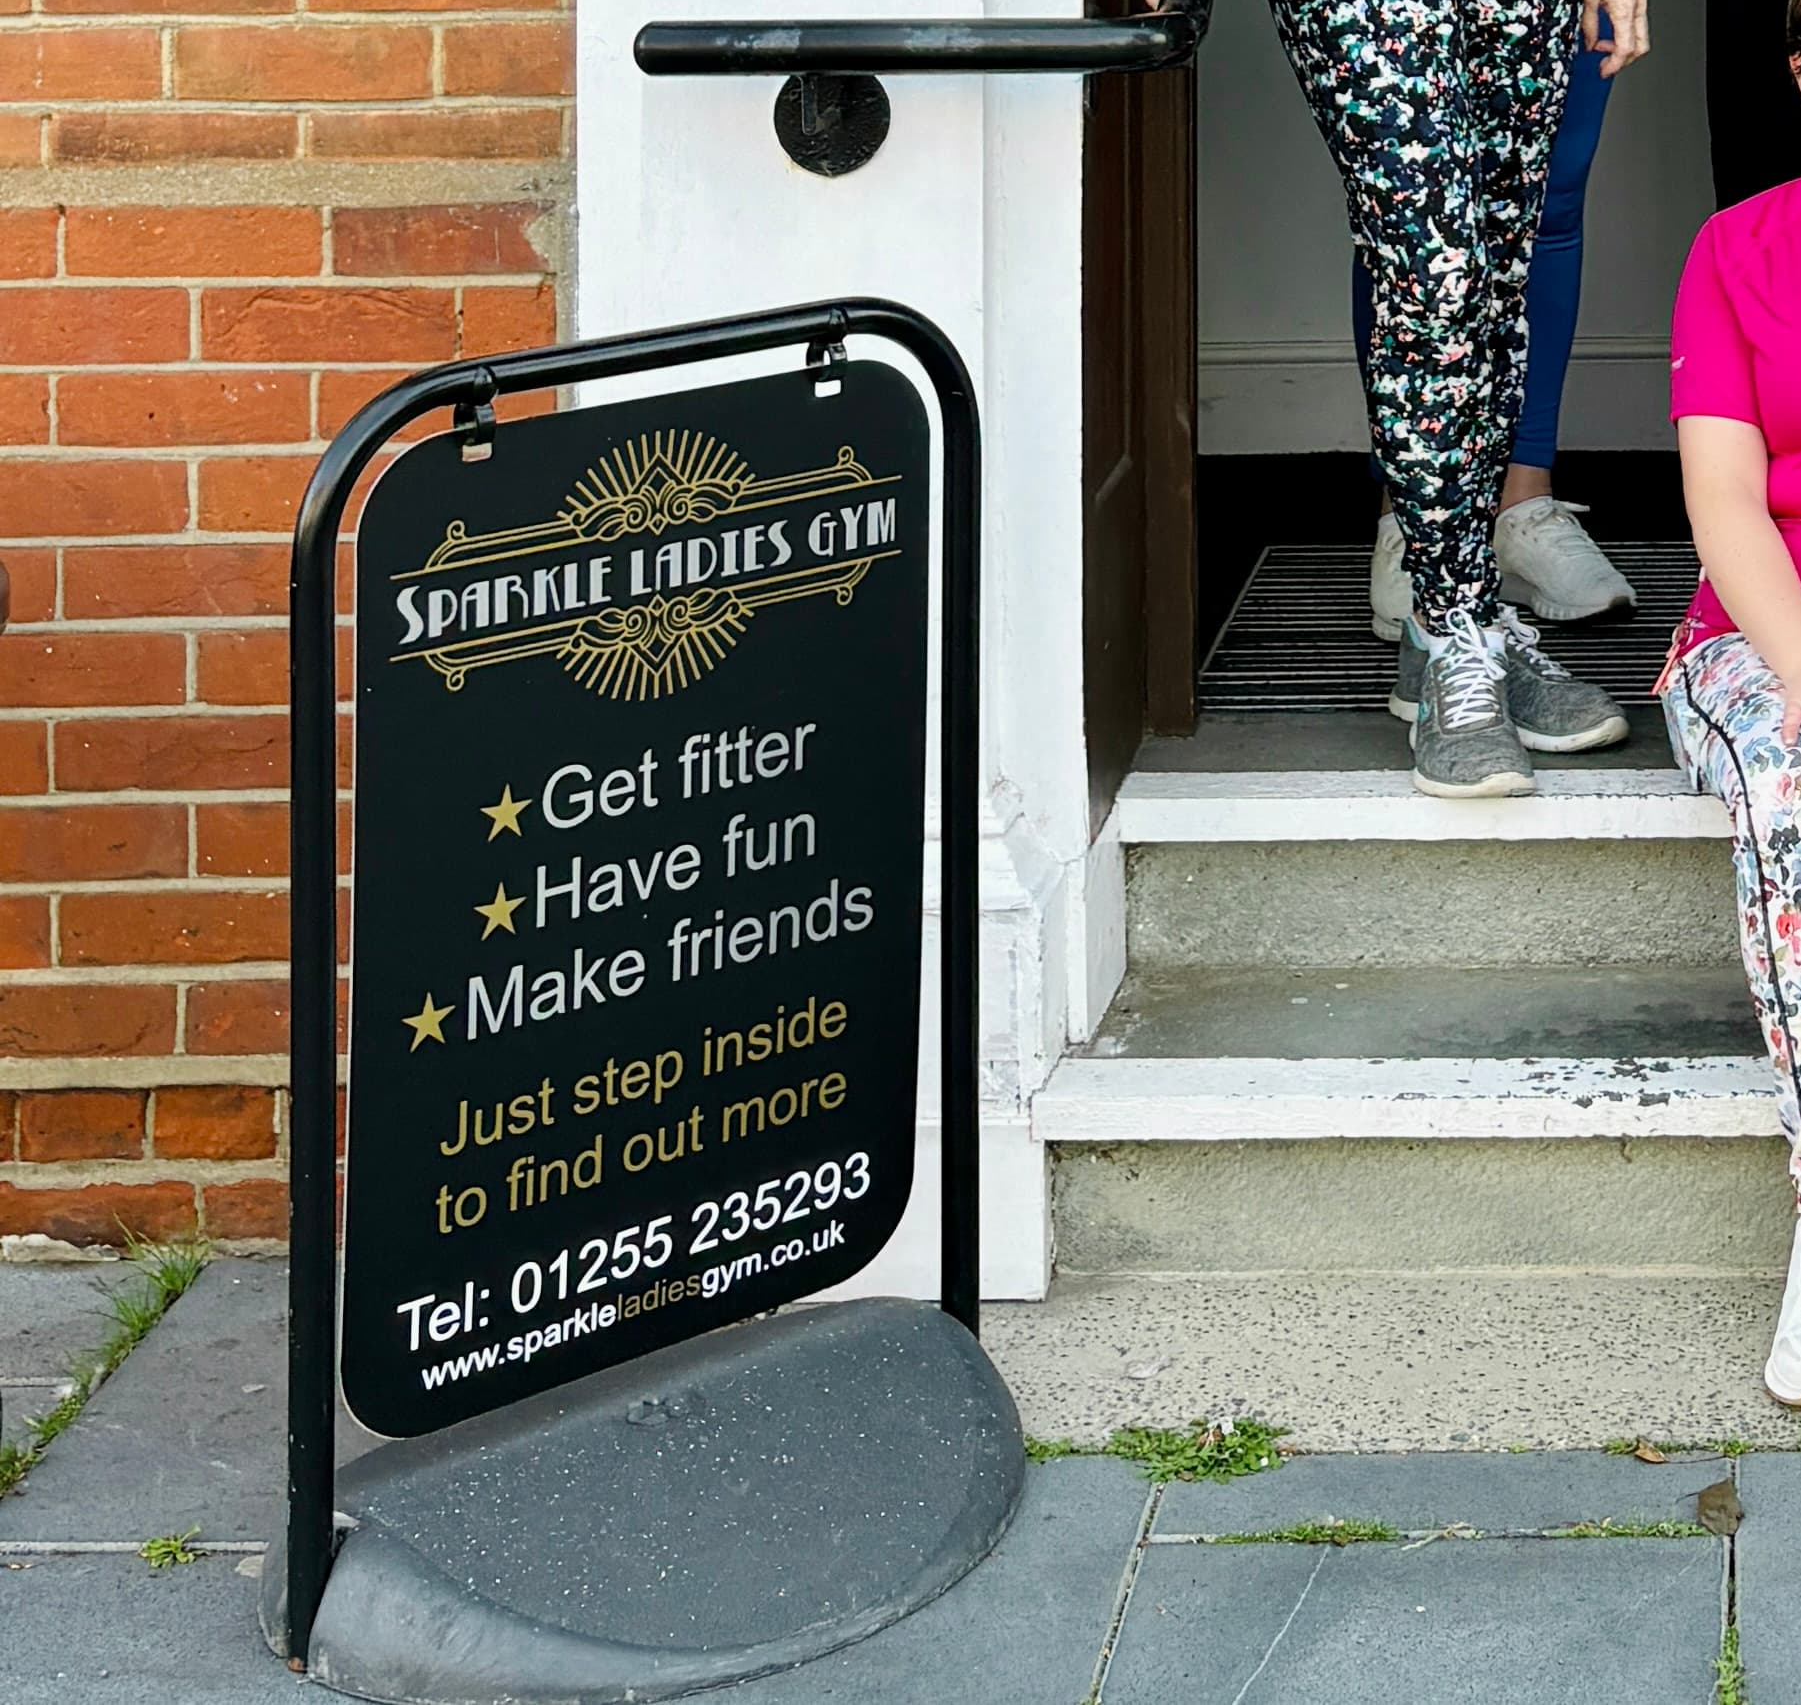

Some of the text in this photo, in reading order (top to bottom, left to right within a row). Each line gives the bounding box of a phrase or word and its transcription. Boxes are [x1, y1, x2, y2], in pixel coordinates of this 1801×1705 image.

[397, 498, 895, 644] SPARKLE LADIES GYM
[543, 724, 816, 828] Get fitter
[536, 814, 814, 927] Have fun
[468, 879, 873, 1040] Make friends
[436, 1073, 845, 1233] to find out more
[441, 997, 846, 1155] Just step inside
[397, 1152, 870, 1351] Tel: 01255 235293
[422, 1215, 844, 1390] www.sparkleladiesgym.co.uk
